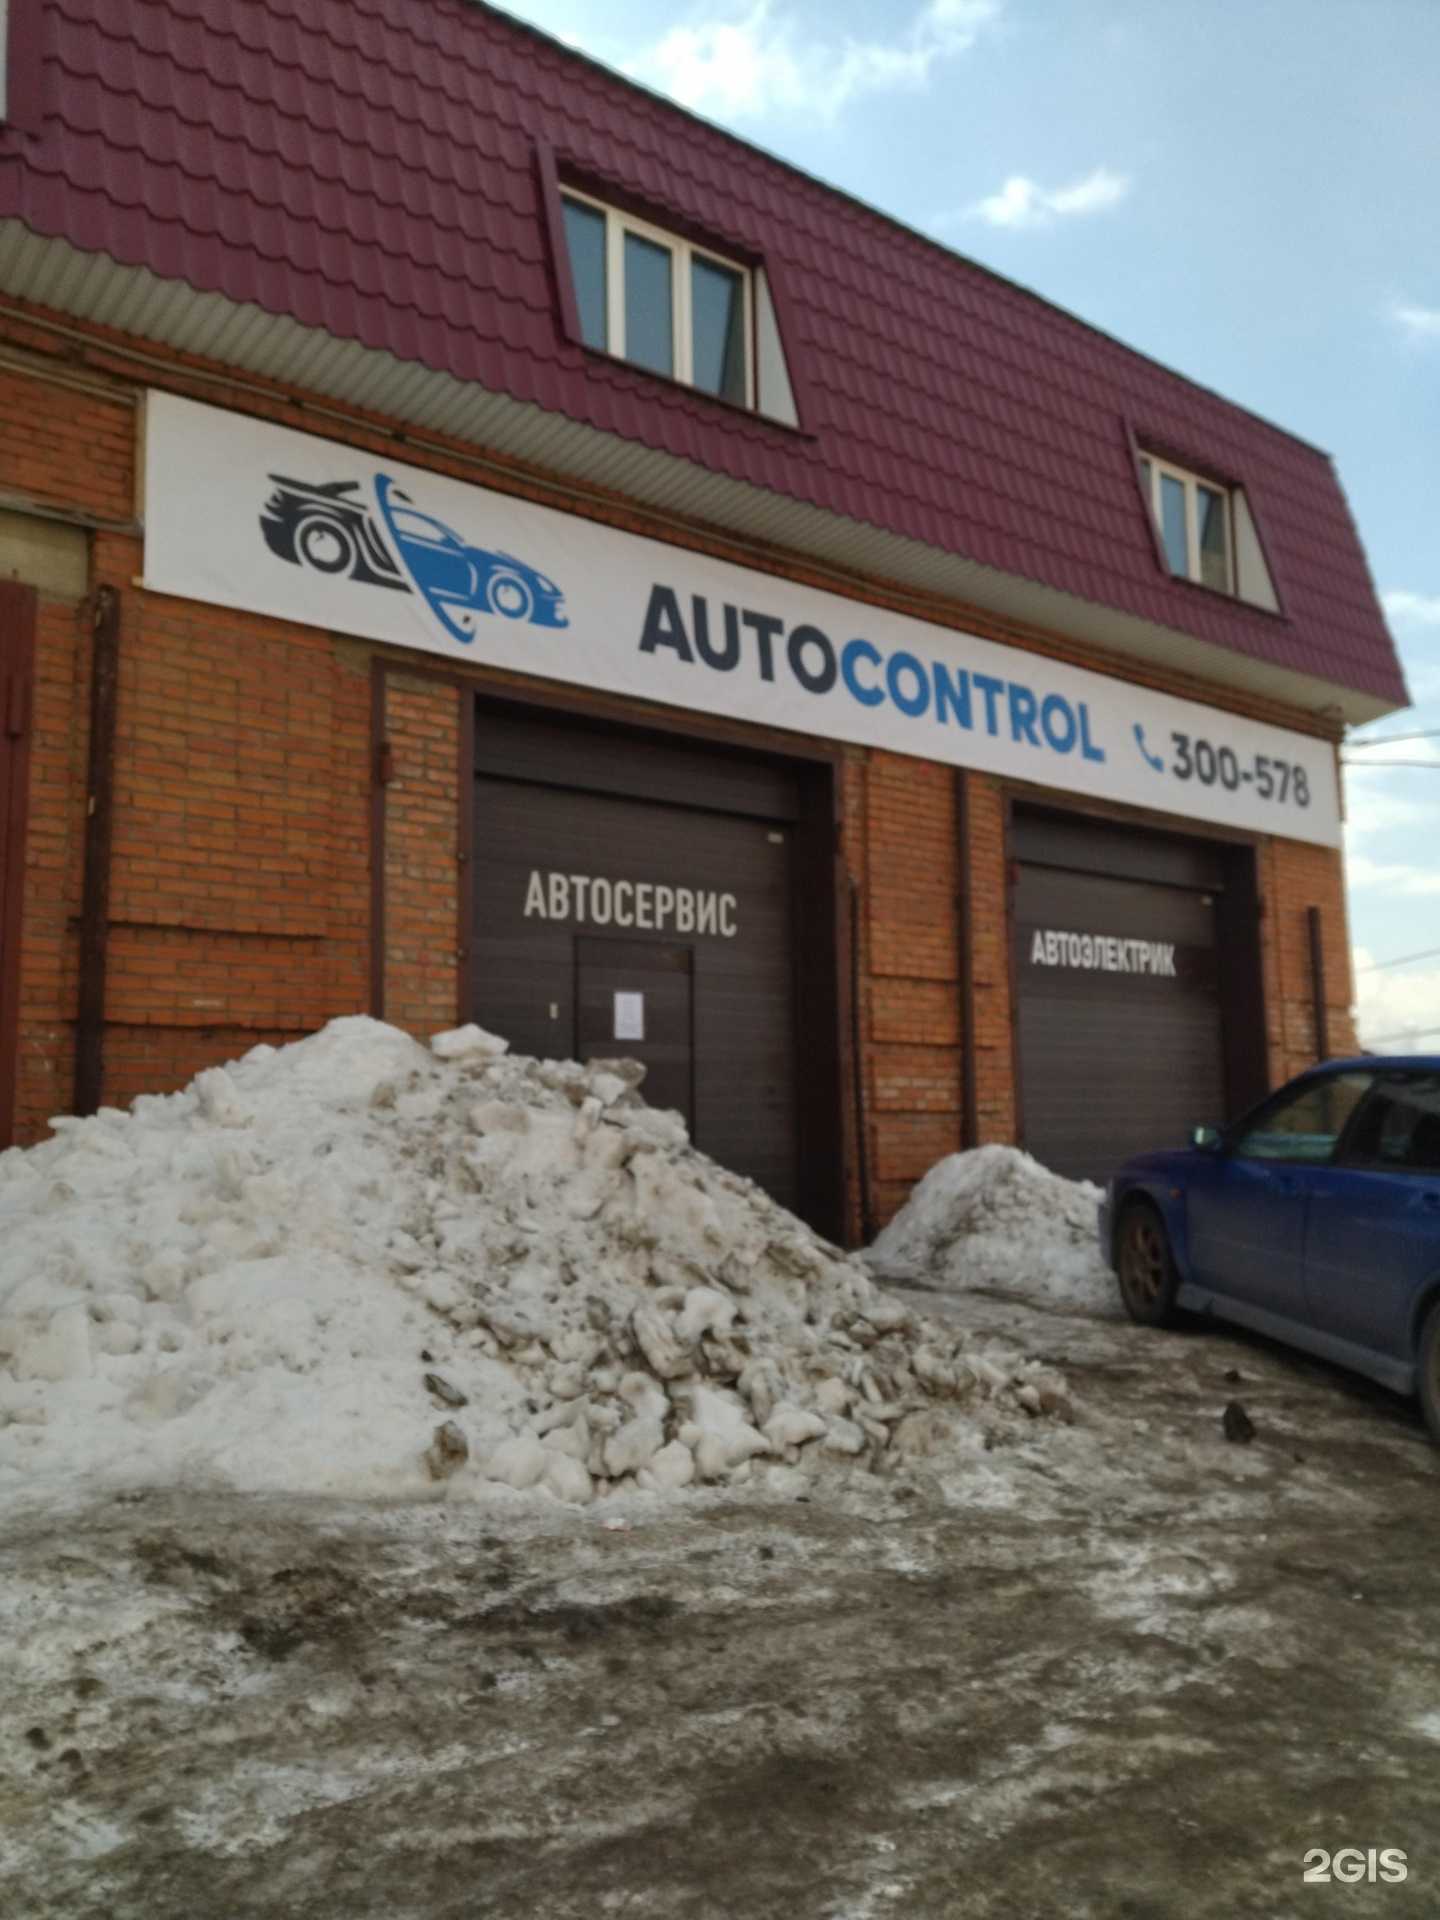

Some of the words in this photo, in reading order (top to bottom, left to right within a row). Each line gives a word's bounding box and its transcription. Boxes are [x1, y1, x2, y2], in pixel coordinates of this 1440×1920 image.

[638, 584, 1105, 763] AUTOCONTROL
[1170, 731, 1311, 809] 300-578
[523, 869, 738, 937] АВТОСЕРВИС
[1030, 929, 1177, 977] АВТОЭЛЕКТРИК
